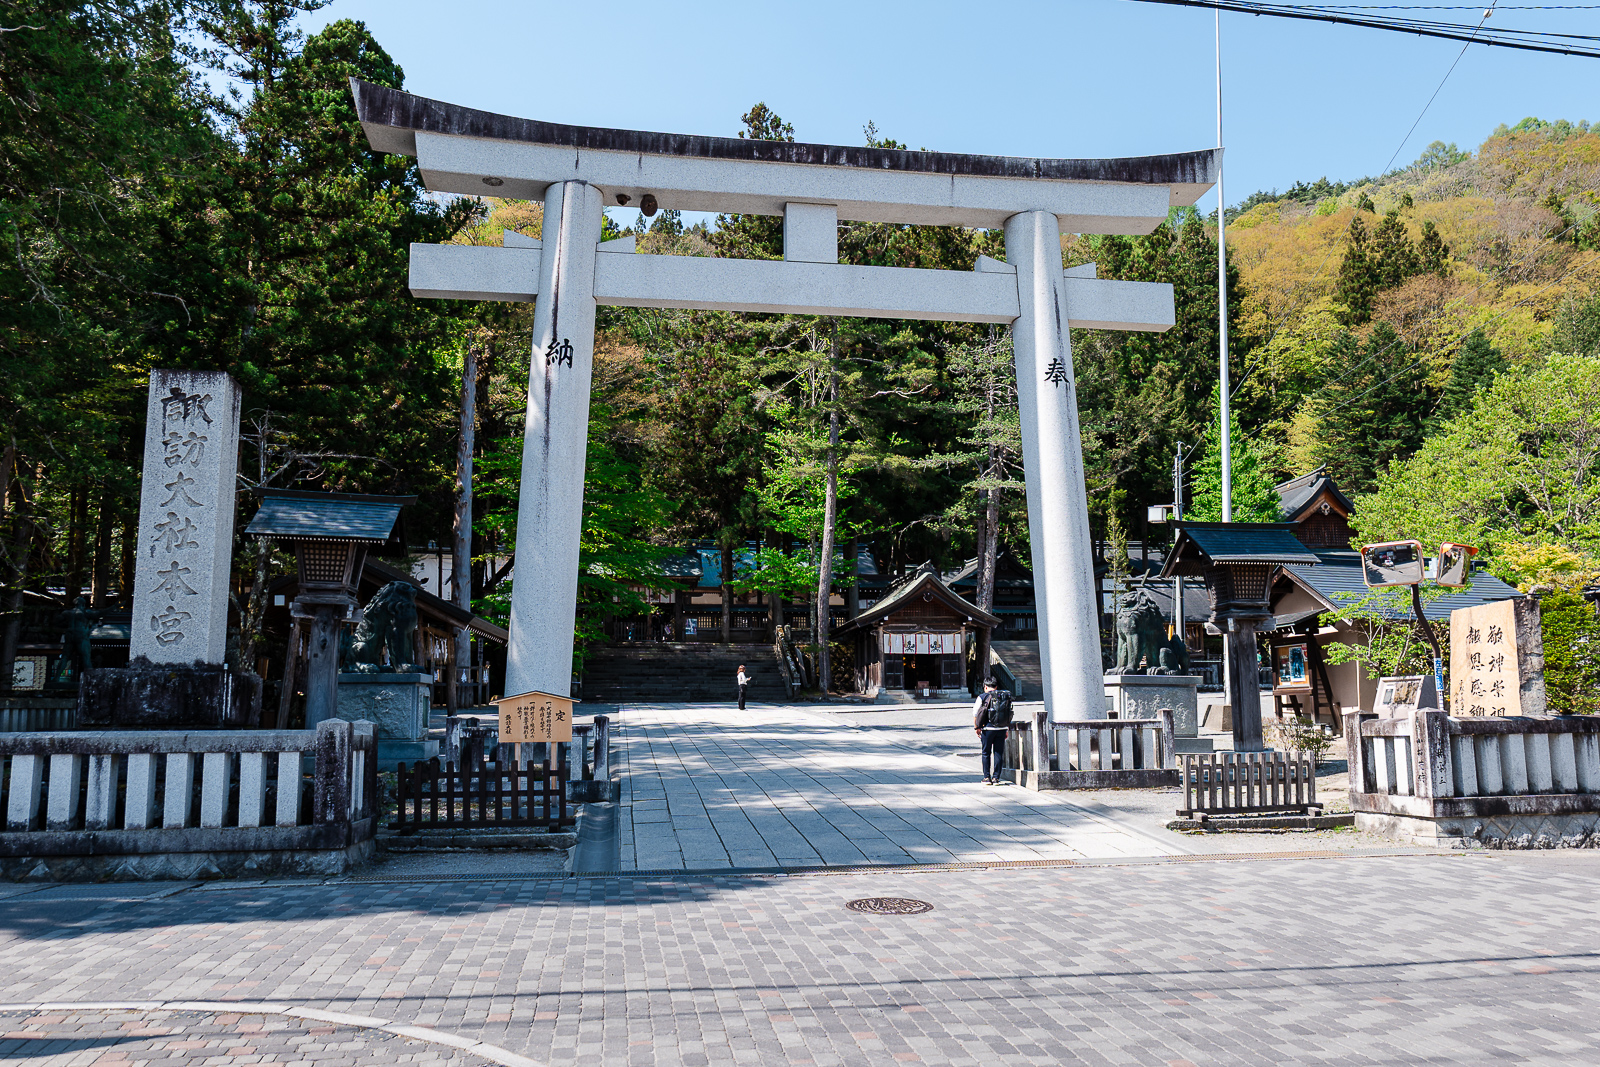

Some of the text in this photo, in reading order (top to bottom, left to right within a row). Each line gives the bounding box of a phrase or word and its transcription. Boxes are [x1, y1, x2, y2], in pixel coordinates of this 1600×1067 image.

[545, 338, 574, 369] 納
[1044, 357, 1070, 389] 奉
[151, 387, 214, 648] 諏訪大社本宮
[555, 710, 566, 722] 定
